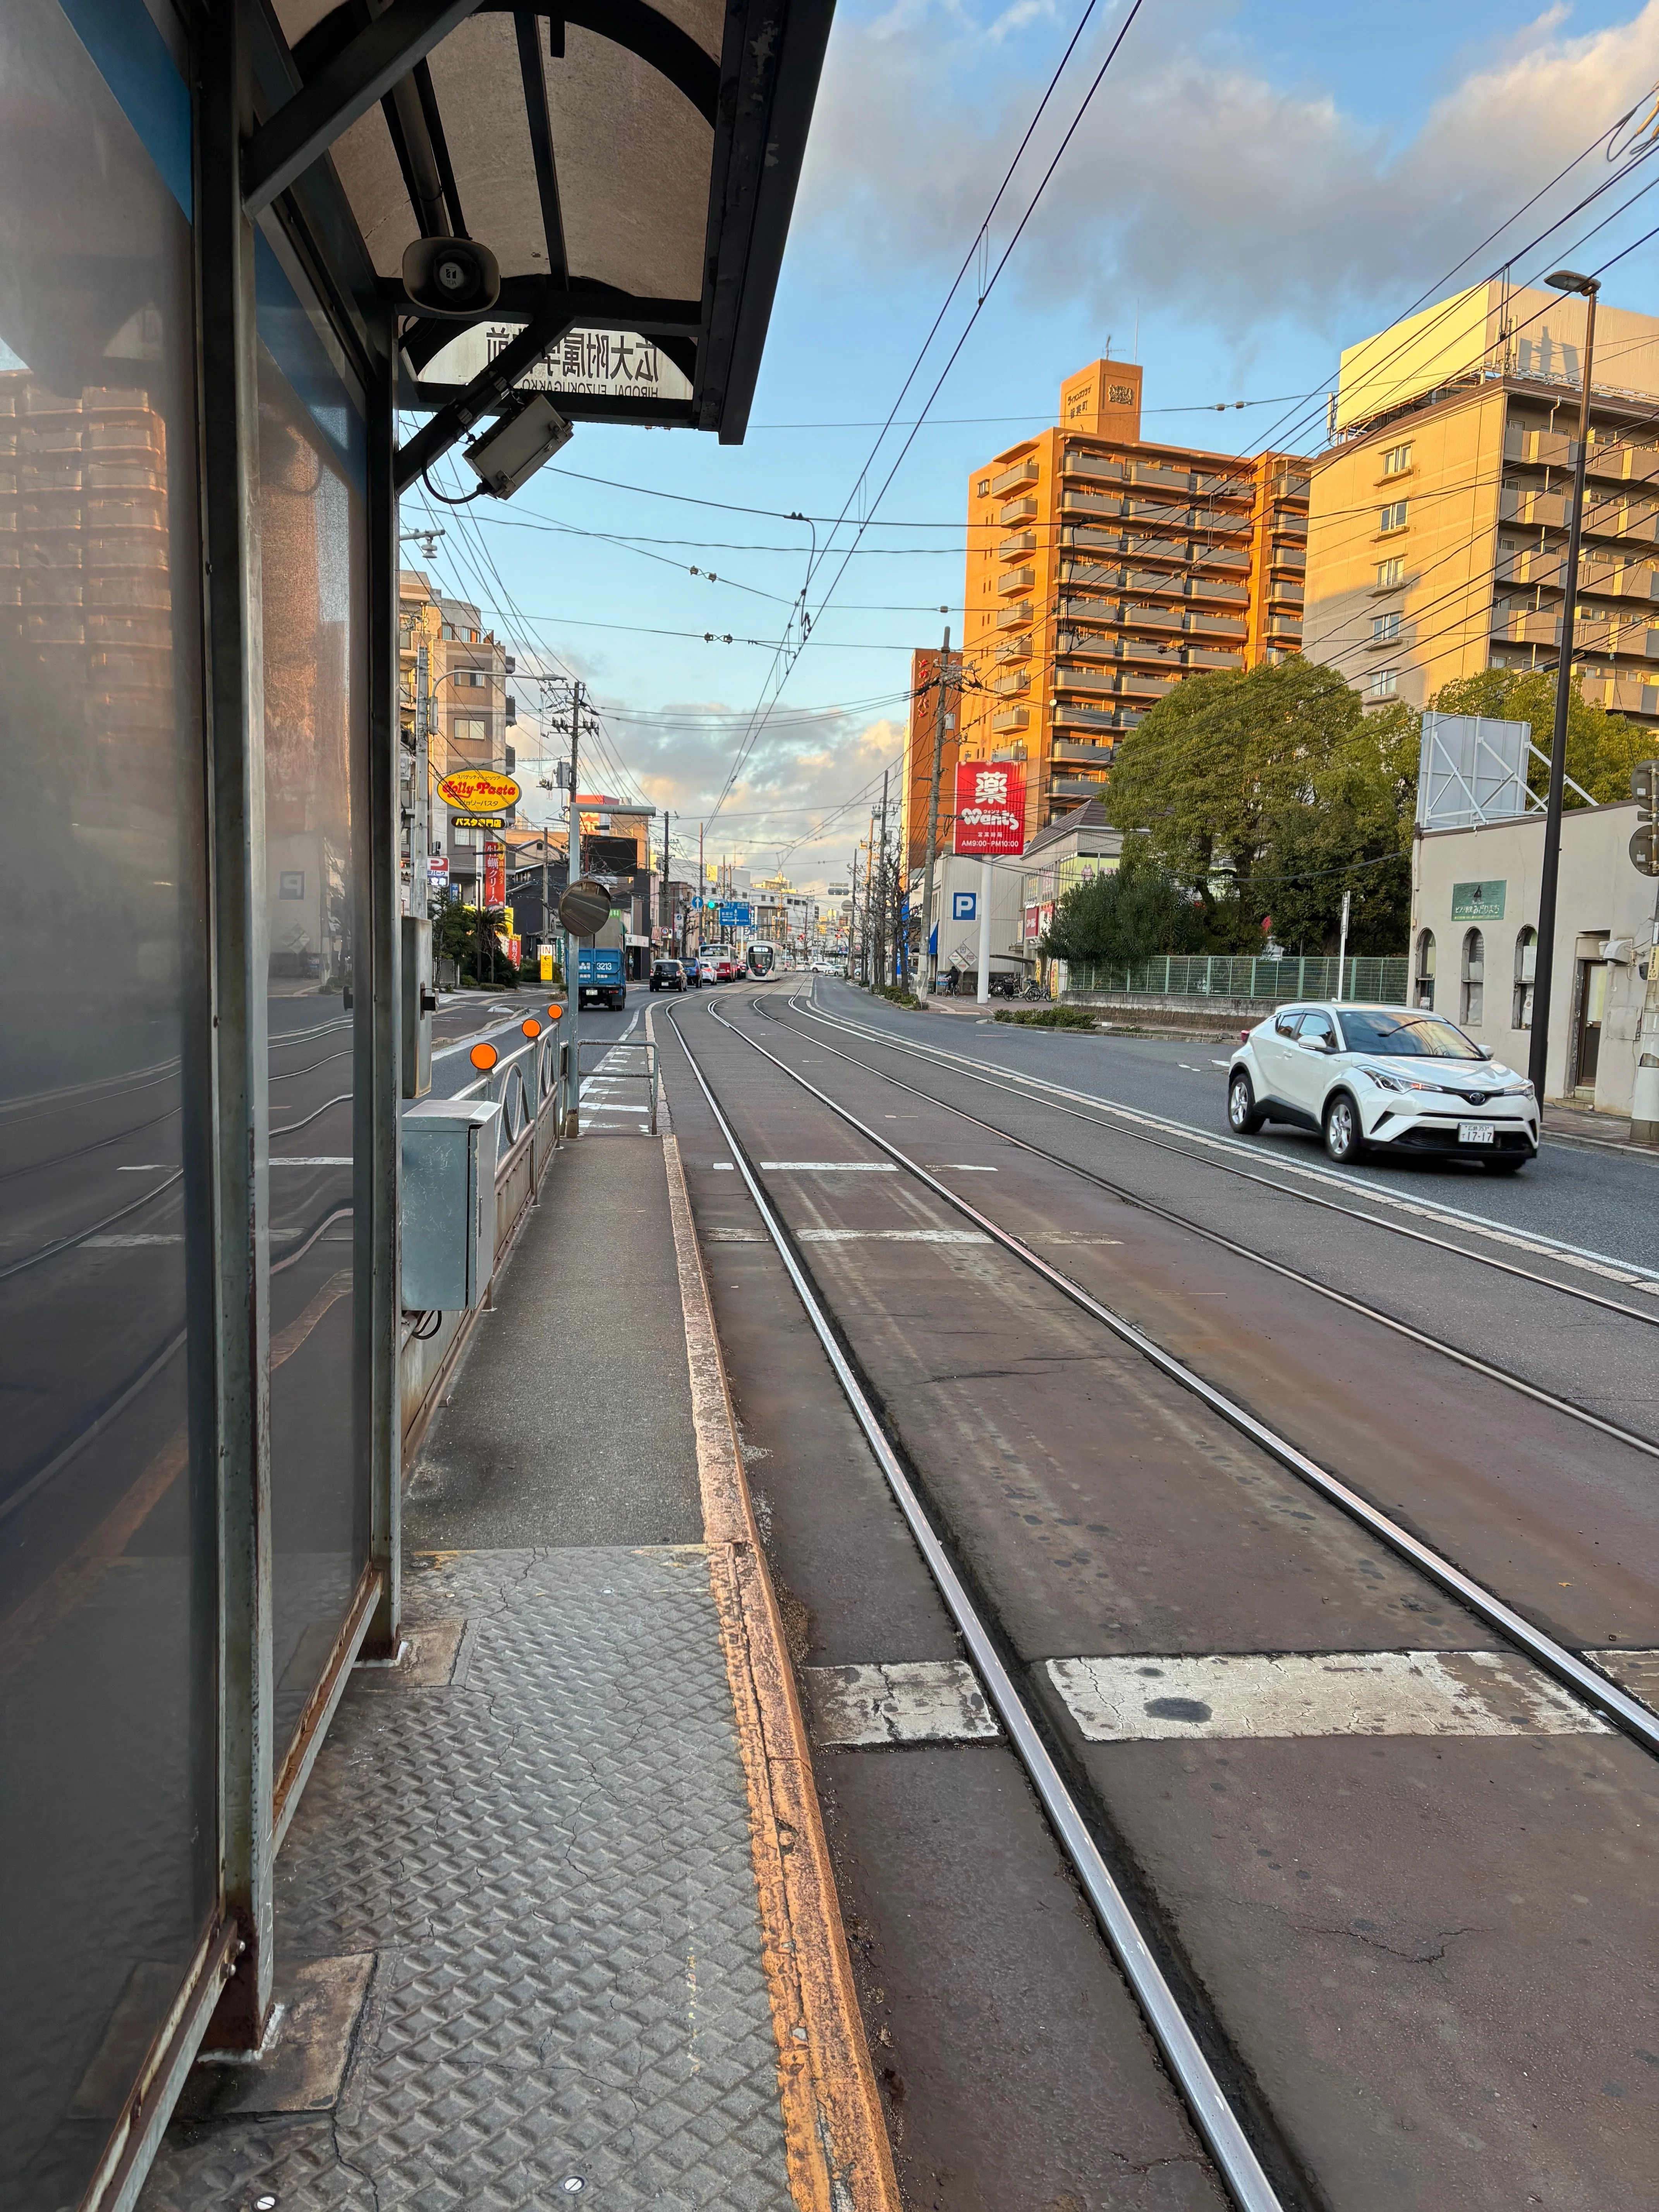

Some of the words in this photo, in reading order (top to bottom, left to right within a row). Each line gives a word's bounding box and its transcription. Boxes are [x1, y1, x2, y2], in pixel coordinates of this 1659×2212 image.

[975, 771, 1008, 804] 薬
[962, 808, 1019, 830] Wants
[956, 896, 974, 917] P
